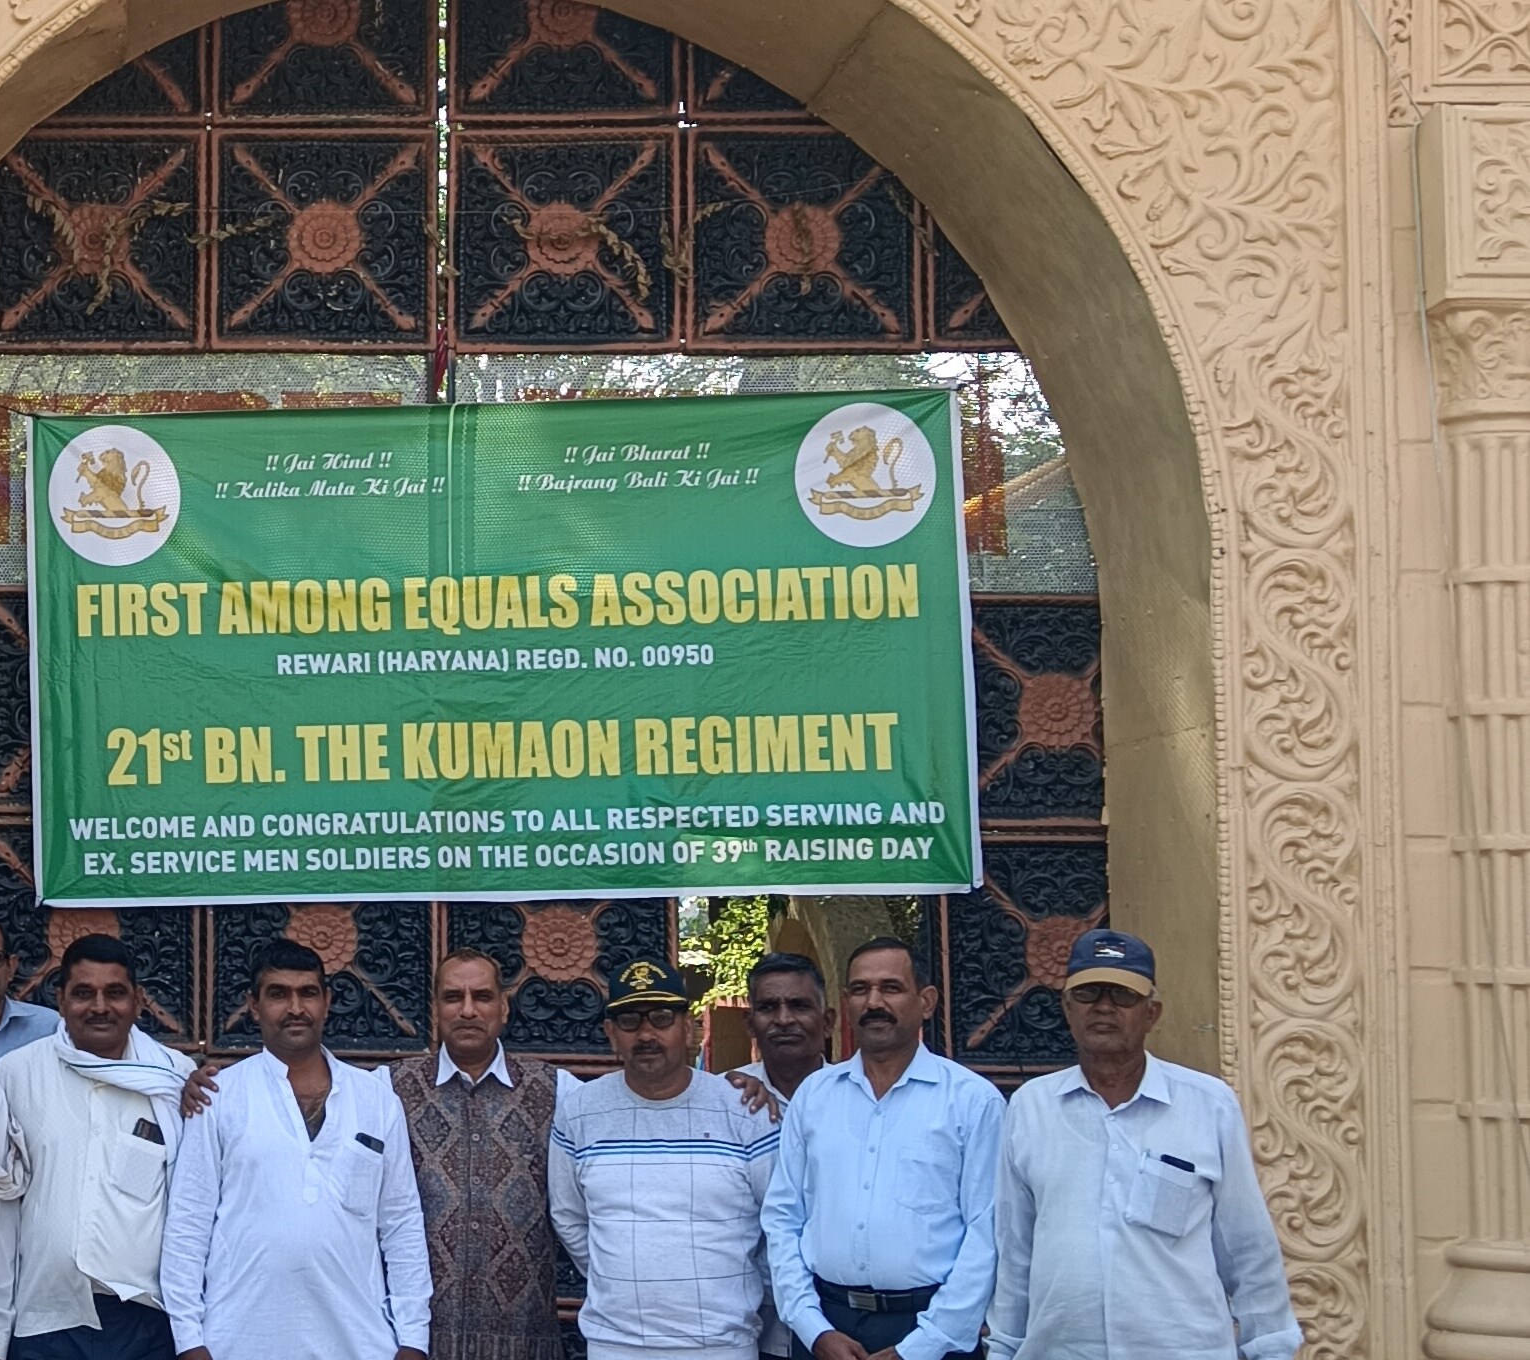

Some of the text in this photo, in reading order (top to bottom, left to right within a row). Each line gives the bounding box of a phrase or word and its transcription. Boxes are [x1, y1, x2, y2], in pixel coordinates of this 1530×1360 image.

[265, 452, 393, 474] !! Jai Hind !!
[564, 442, 711, 466] !! Jai Bharat !!
[215, 477, 446, 499] !! Kalika Mata Ki Jai !!
[517, 468, 759, 493] !! Bajrang Bali Ki Jai !!
[76, 563, 919, 637] FIRST AMONG EQUALS ASSOCIATION
[277, 644, 714, 675] REWARI (HARYANA) REGD. NO. 00950
[107, 712, 898, 786] 21st BN. THE KUMAON REGIMENT
[69, 801, 945, 841] WELCOME AND CONGRATULATIONS TO ALL RESPECTED SERVING AND
[84, 836, 935, 876] EX. SERVICE MEN SOLDIERS ON THE OCCASION OF 39th RAISING DAY
